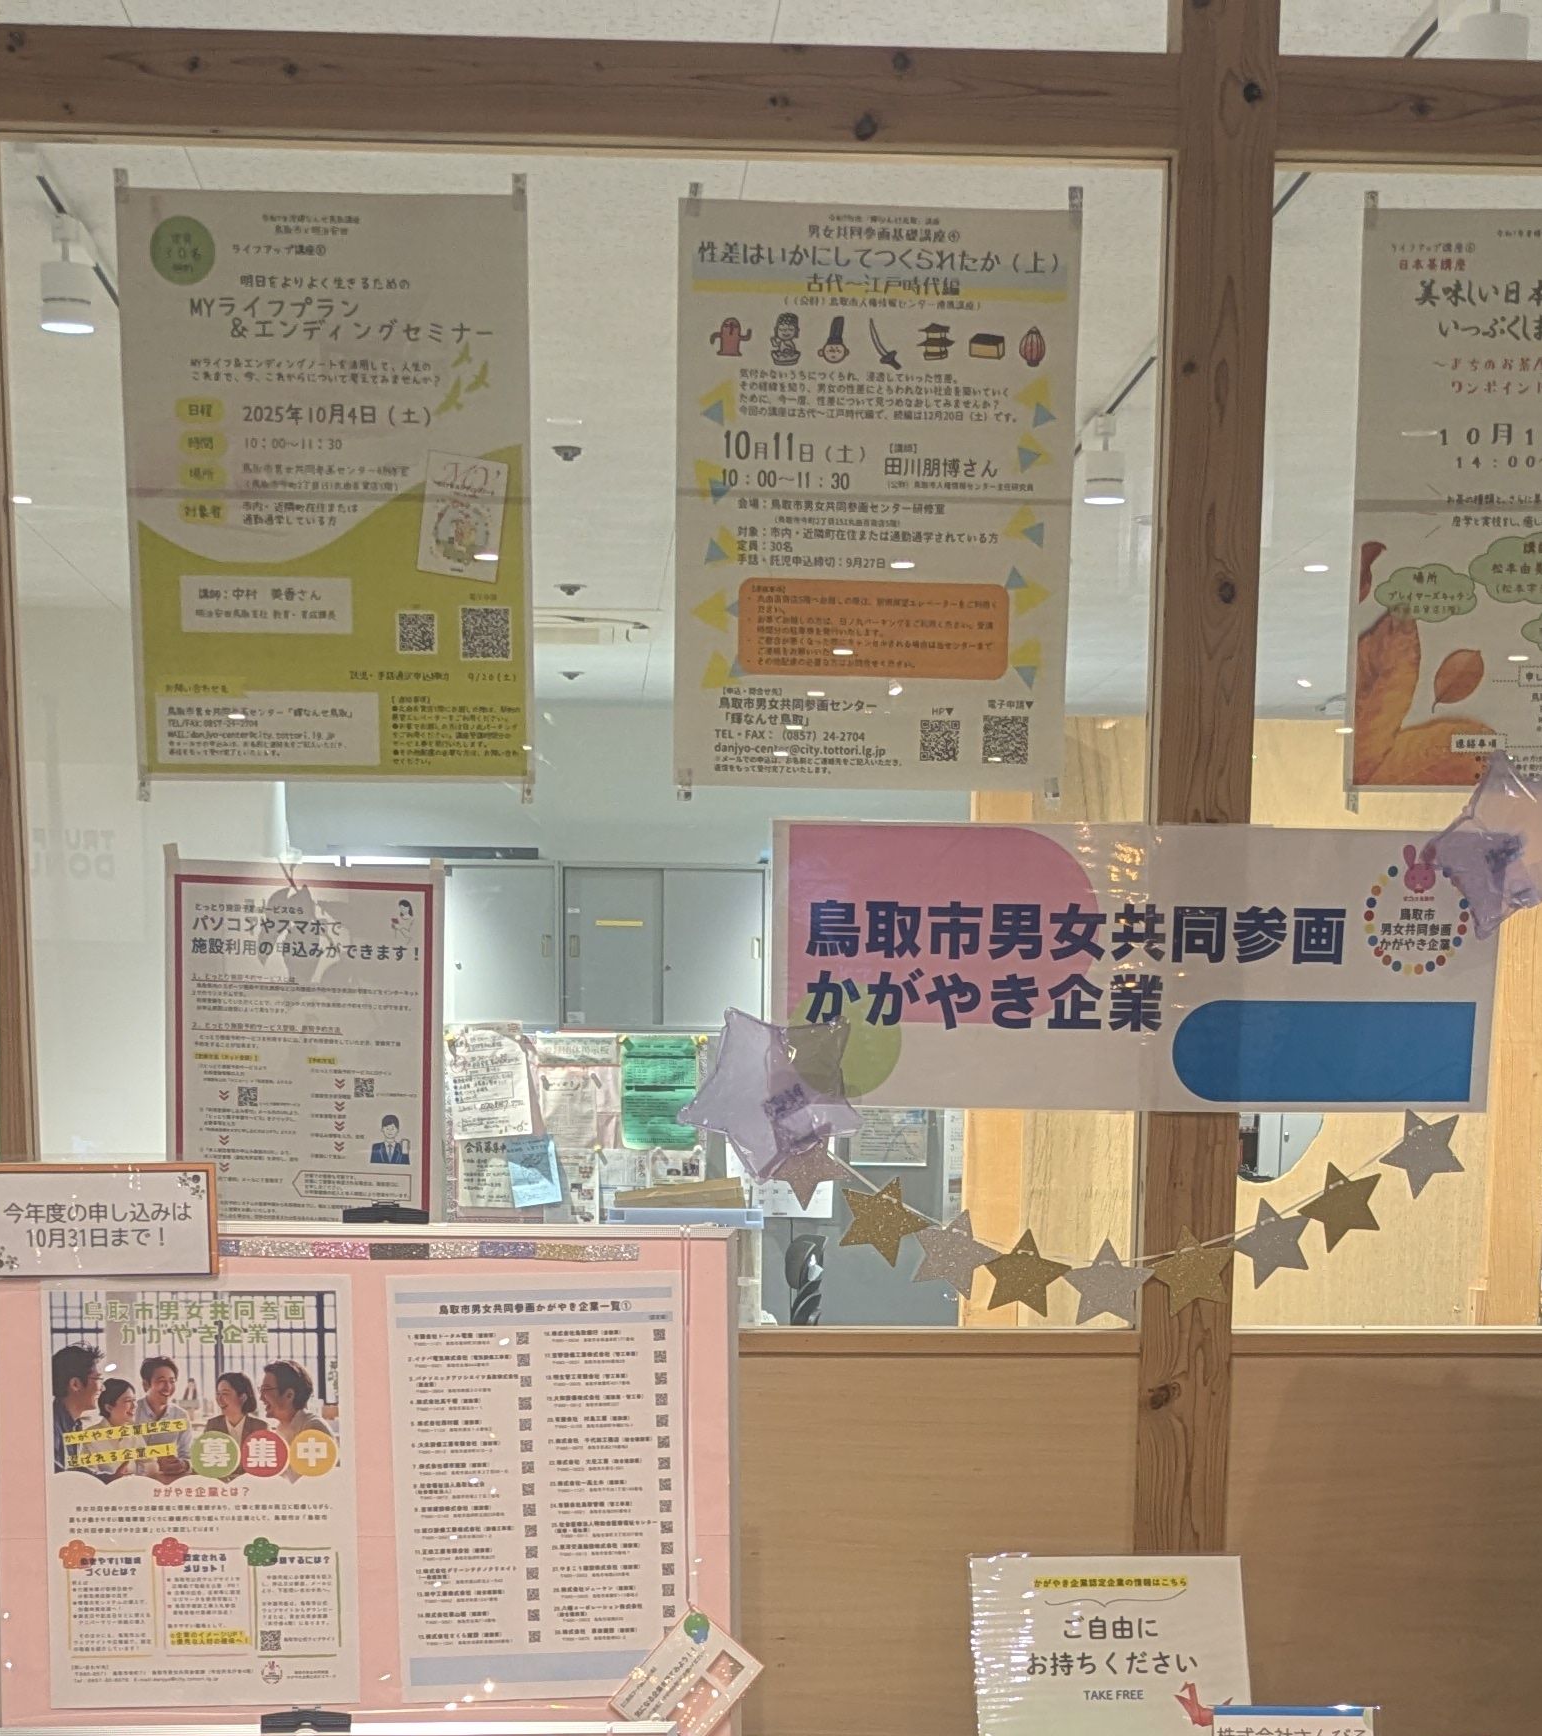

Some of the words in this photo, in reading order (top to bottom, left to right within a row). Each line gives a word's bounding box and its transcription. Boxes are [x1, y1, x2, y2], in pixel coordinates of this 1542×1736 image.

[190, 297, 359, 318] MYライフプラン
[884, 457, 998, 479] 田川朋博さん
[1400, 908, 1436, 921] 鳥取市
[804, 900, 1347, 966] 鳥取市男女共同参画
[1380, 923, 1452, 937] 男女共同参画
[1379, 938, 1451, 951] かがやき企業
[805, 970, 1165, 1033] かがやき企業
[3, 1201, 192, 1225] 今年度の申し込みは
[83, 1300, 306, 1322] 鳥取市男女共同参画
[122, 1324, 270, 1344] かがやき企業
[199, 1438, 327, 1469] 募集中
[1061, 1615, 1160, 1641] ご自由に
[1025, 1650, 1199, 1677] お持ちください
[1083, 1689, 1112, 1701] TAKE
[1116, 1689, 1144, 1702] FREE
